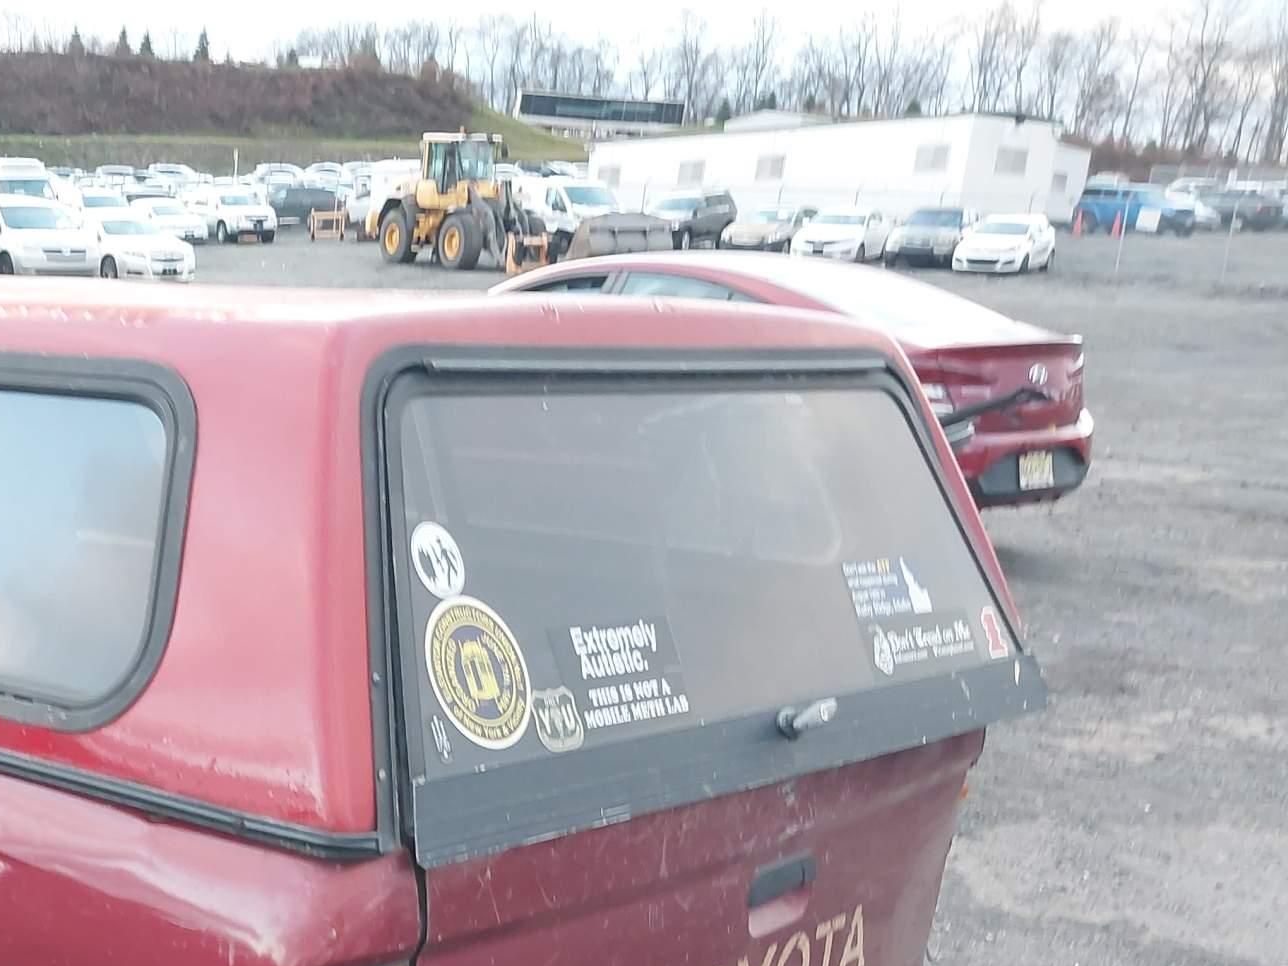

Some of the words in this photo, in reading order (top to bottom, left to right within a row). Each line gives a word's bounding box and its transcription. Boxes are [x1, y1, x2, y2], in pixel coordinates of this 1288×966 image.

[570, 619, 657, 656] Extremely
[589, 686, 618, 707] THIS
[619, 683, 632, 702] IS
[633, 679, 659, 698] NOT
[662, 677, 671, 695] A
[584, 704, 631, 729] MOBILE
[631, 697, 667, 721] METH
[666, 694, 689, 715] LAB
